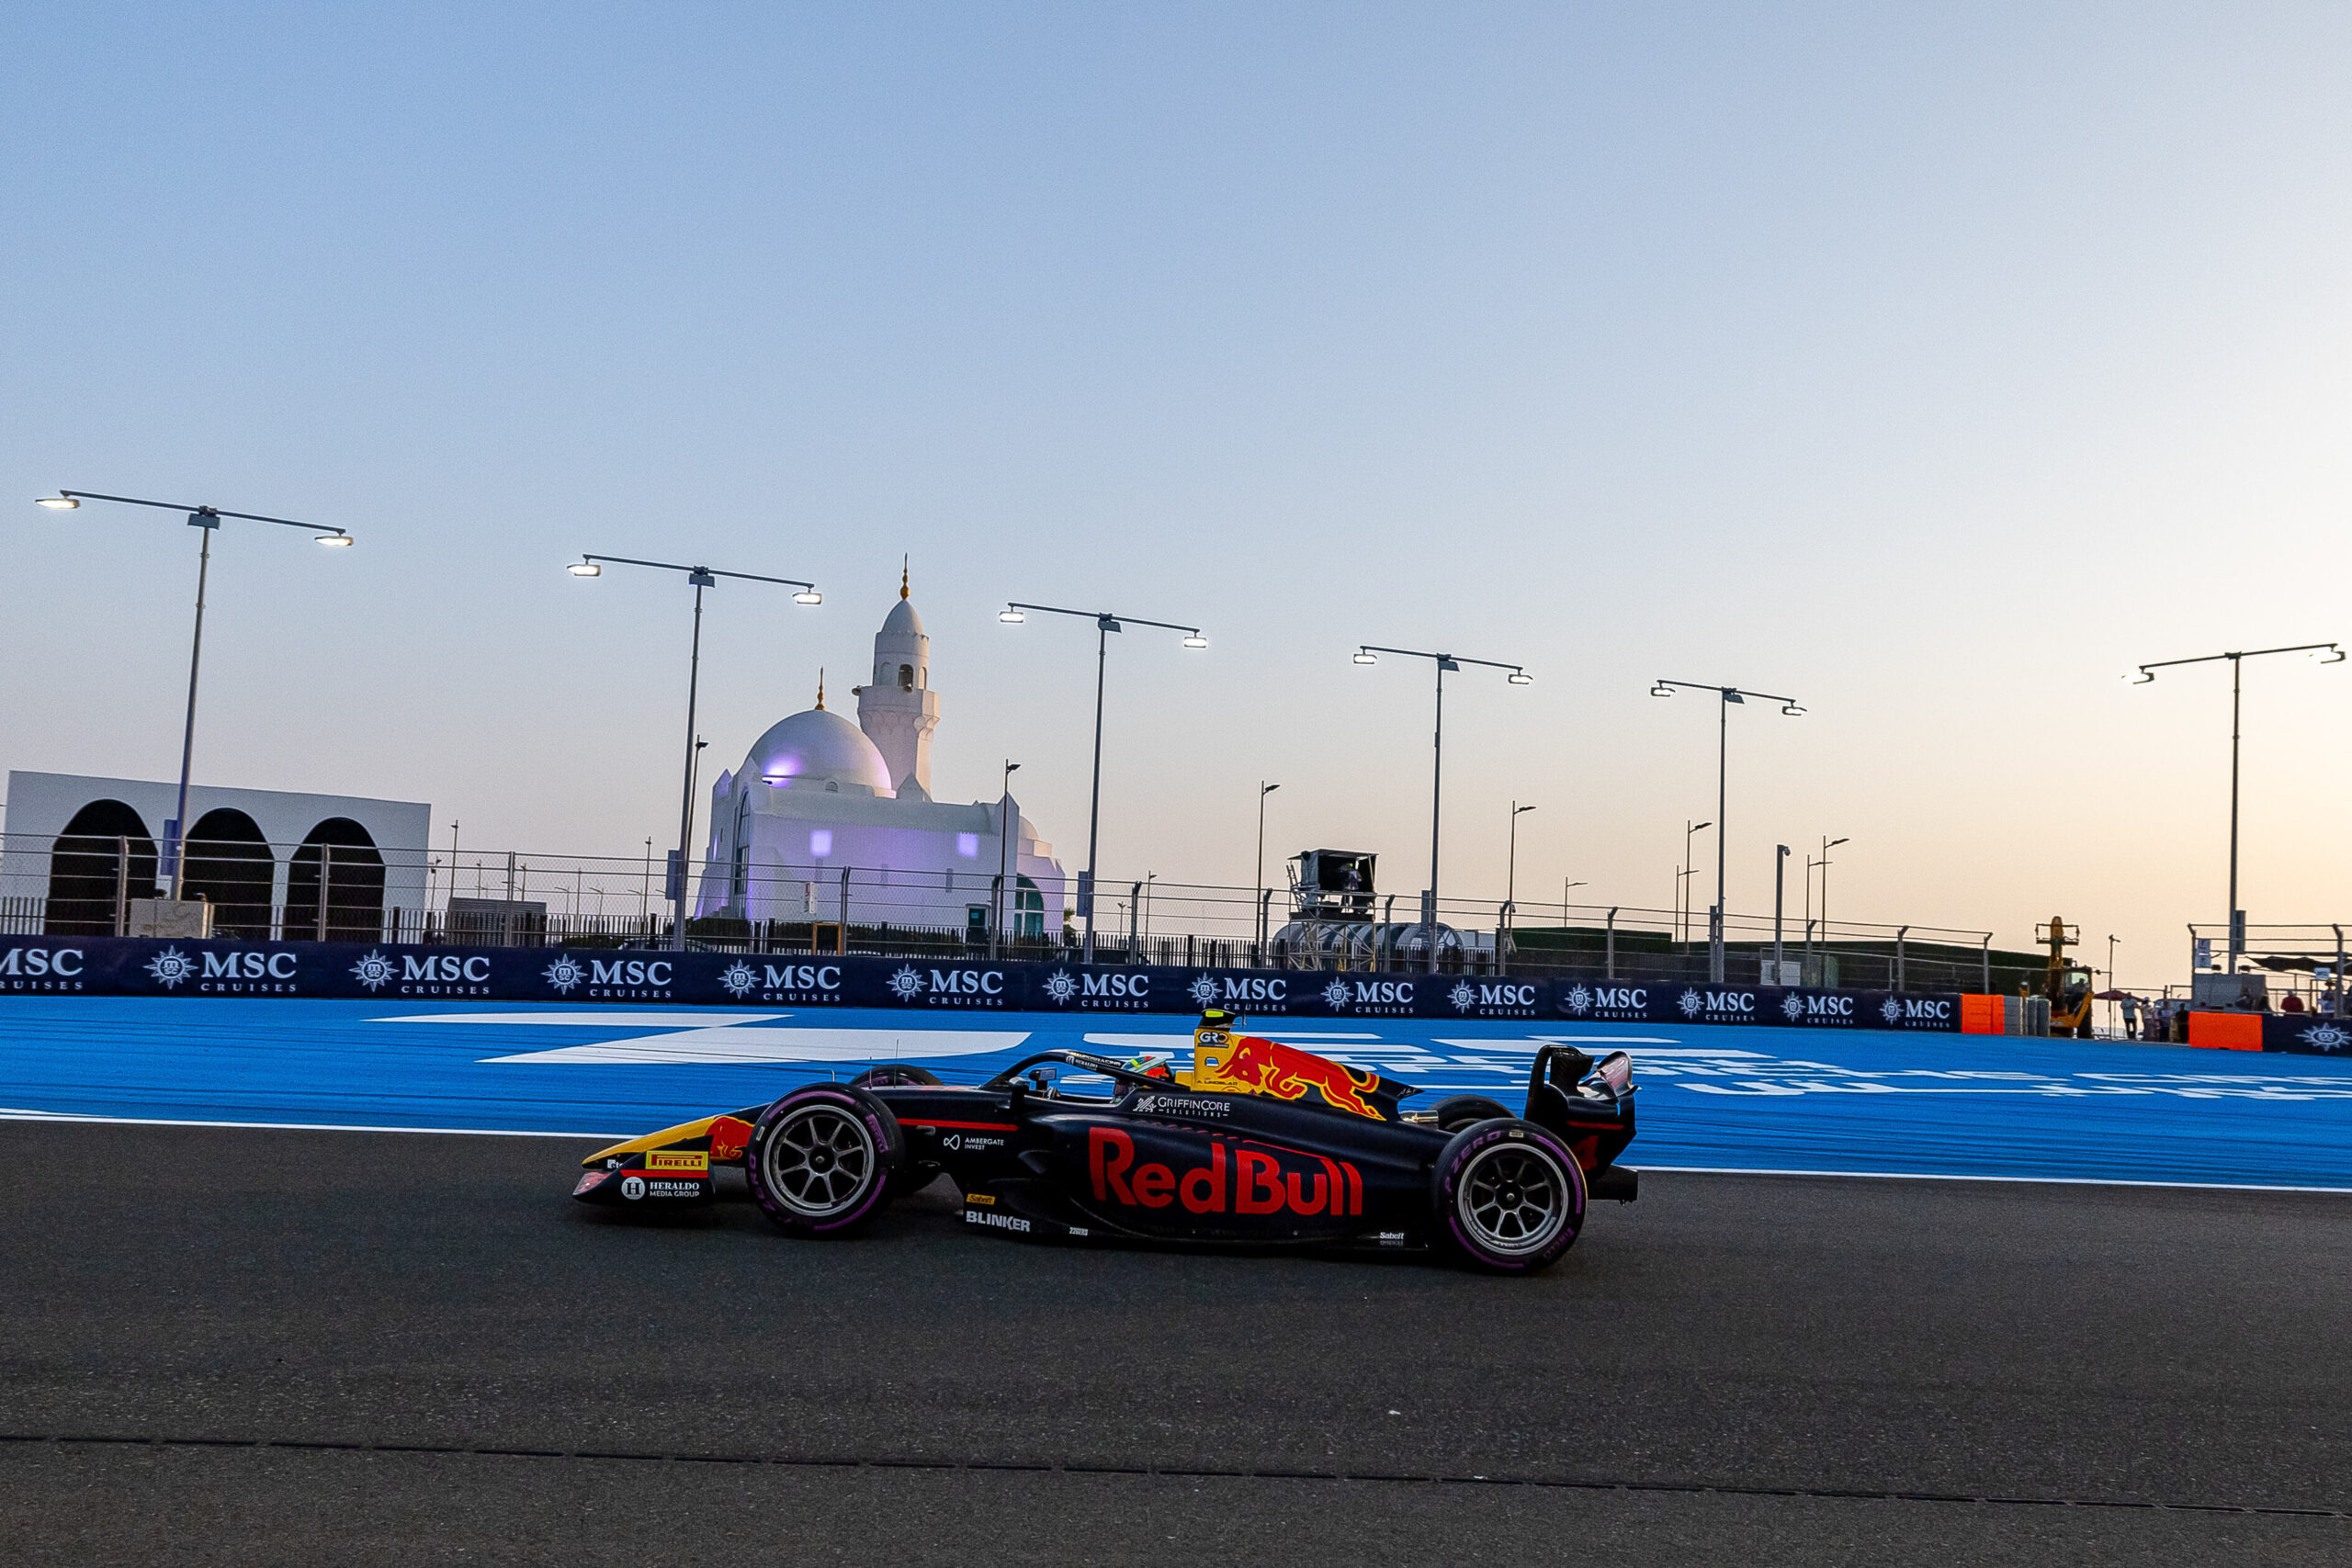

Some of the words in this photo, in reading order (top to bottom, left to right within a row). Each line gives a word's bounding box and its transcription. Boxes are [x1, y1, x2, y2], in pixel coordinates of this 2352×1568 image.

[0, 948, 84, 976] MSC
[200, 952, 297, 979] MSC
[401, 955, 491, 982] MSC
[590, 960, 672, 986] MSC
[763, 964, 841, 990] MSC
[930, 969, 1003, 994] MSC
[200, 983, 296, 992] CRUISES
[401, 986, 489, 995] CRUISES
[589, 988, 672, 998] CRUISES
[1081, 973, 1148, 998] MSC
[1224, 977, 1286, 1001] MSC
[1355, 981, 1414, 1003] MSC
[1480, 984, 1535, 1006] MSC
[763, 992, 840, 1002] CRUISES
[929, 997, 1002, 1006] CRUISES
[1081, 999, 1148, 1009] CRUISES
[1224, 1003, 1286, 1011] CRUISES
[1595, 987, 1647, 1009] MSC
[1705, 991, 1755, 1011] MSC
[1807, 996, 1853, 1015] MSC
[1355, 1006, 1414, 1014] CRUISES
[1905, 999, 1950, 1019] MSC
[1166, 1109, 1221, 1118] SOLUTIONS
[965, 1136, 1004, 1146] AMBERGATE
[650, 1153, 704, 1168] PIRELLI
[1451, 1130, 1502, 1174] ZERO
[650, 1181, 700, 1191] HERALDO
[966, 1211, 1031, 1232] BLINKER
[1379, 1232, 1405, 1240] Sabelt
